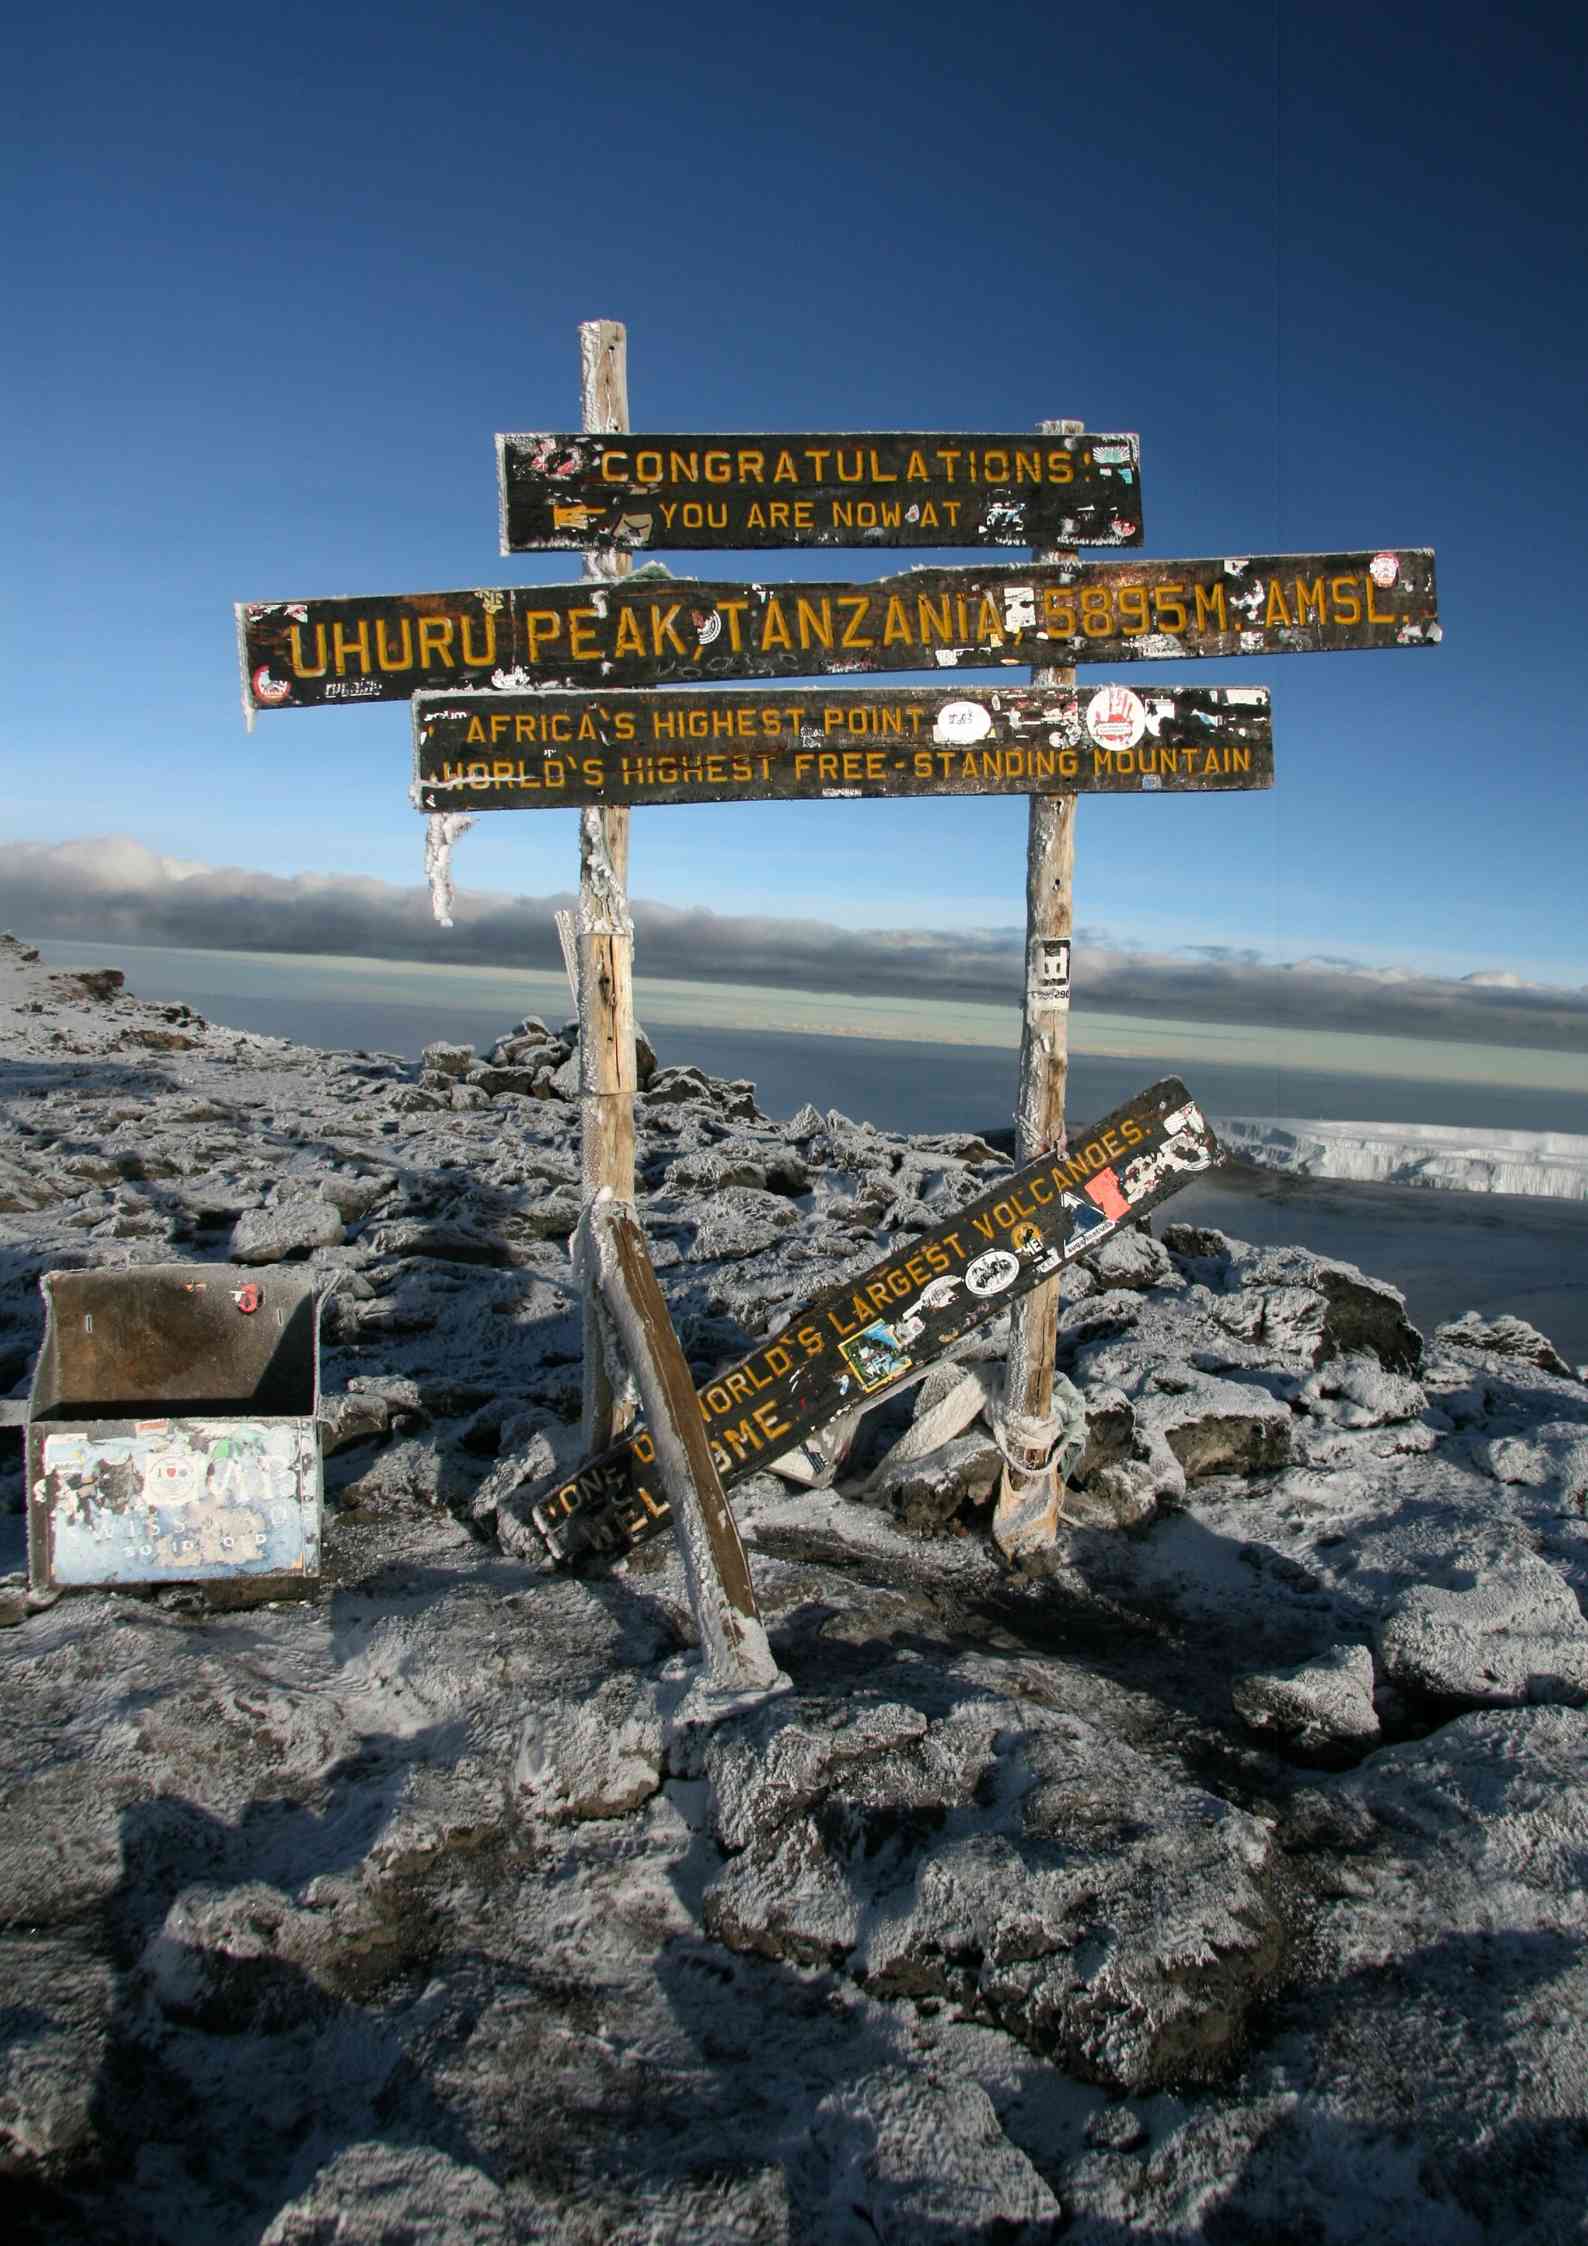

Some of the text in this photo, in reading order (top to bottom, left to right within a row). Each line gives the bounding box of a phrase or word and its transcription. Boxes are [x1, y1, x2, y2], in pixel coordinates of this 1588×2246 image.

[659, 501, 961, 529] YOU ARE NOW AT
[290, 614, 497, 678] UHURU
[466, 708, 636, 744] AFRICA'S
[653, 708, 805, 739] HIGHEST
[823, 706, 925, 736] POINT
[621, 754, 776, 785] HIGHEST
[1093, 747, 1251, 777] MOUNTAIN
[826, 1232, 967, 1336] LARGEST
[971, 1119, 1153, 1241] VOLCANOES.
